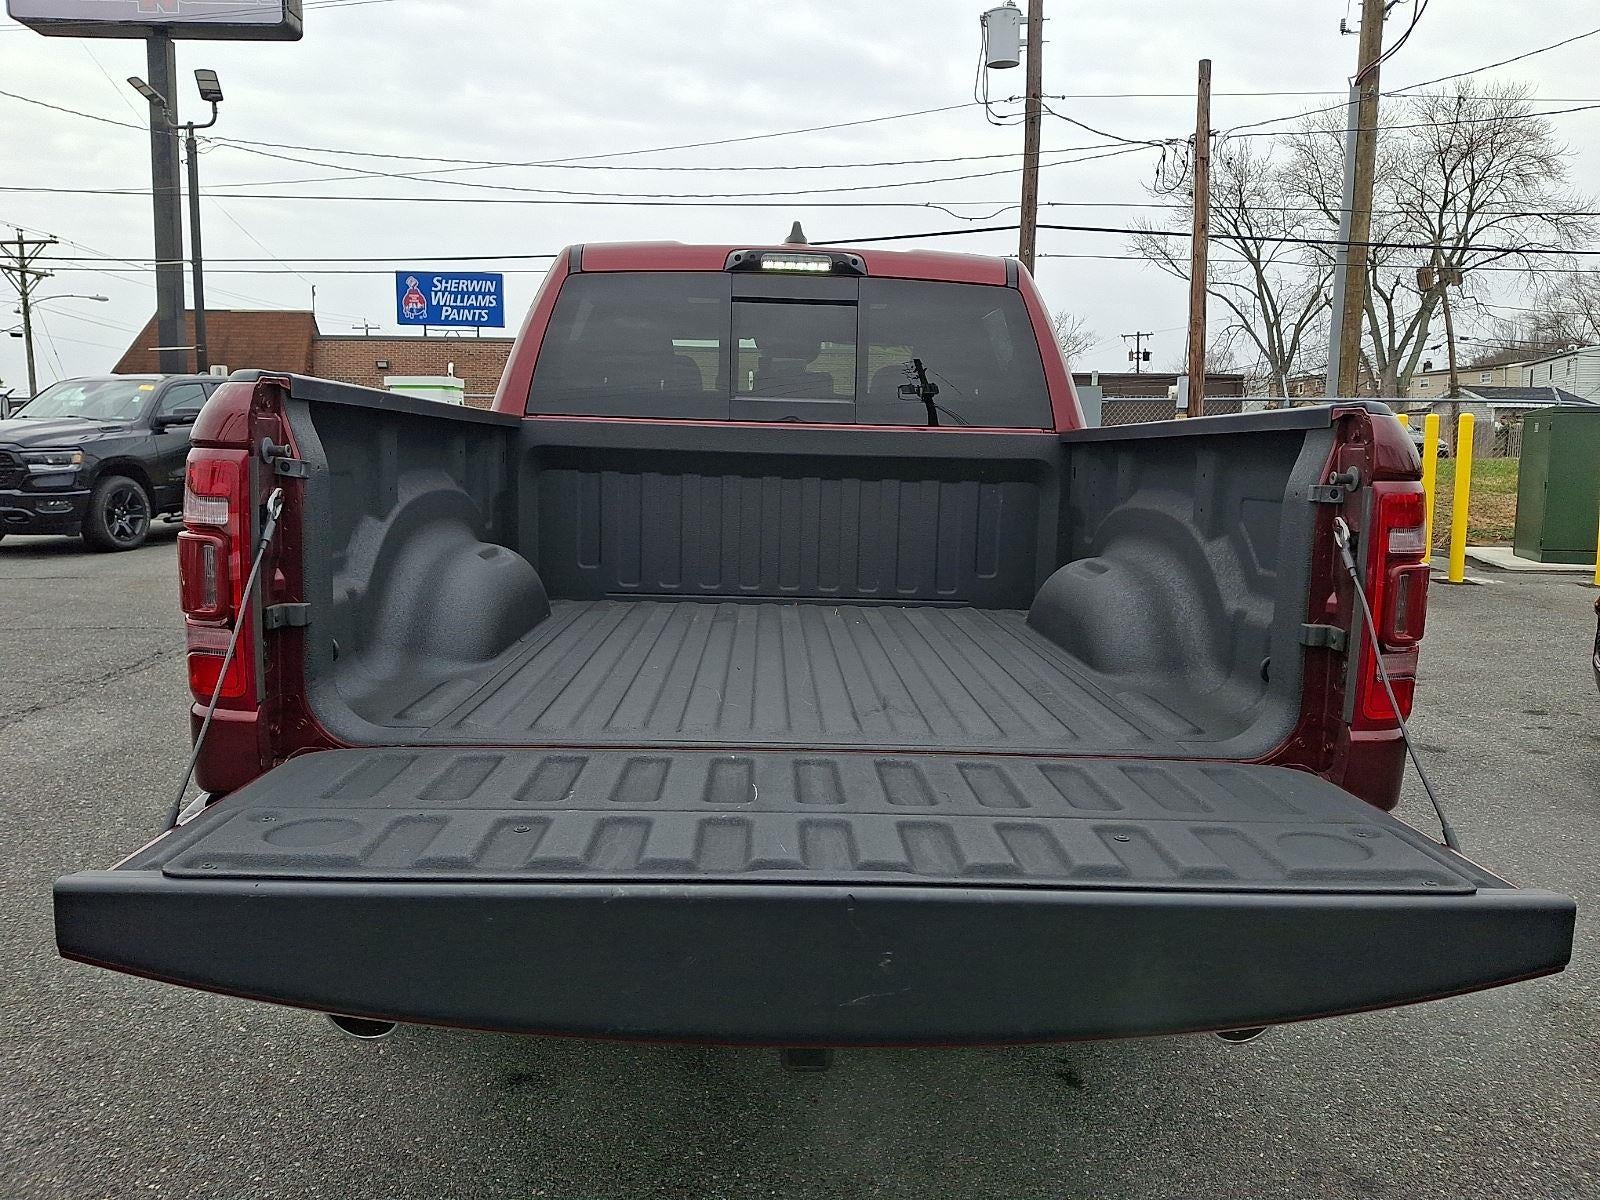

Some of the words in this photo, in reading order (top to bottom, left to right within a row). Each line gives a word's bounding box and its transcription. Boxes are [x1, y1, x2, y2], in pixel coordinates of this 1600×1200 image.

[431, 276, 496, 293] SHERWIN
[430, 291, 497, 307] WILLIAMS
[440, 306, 489, 322] PAINTS
